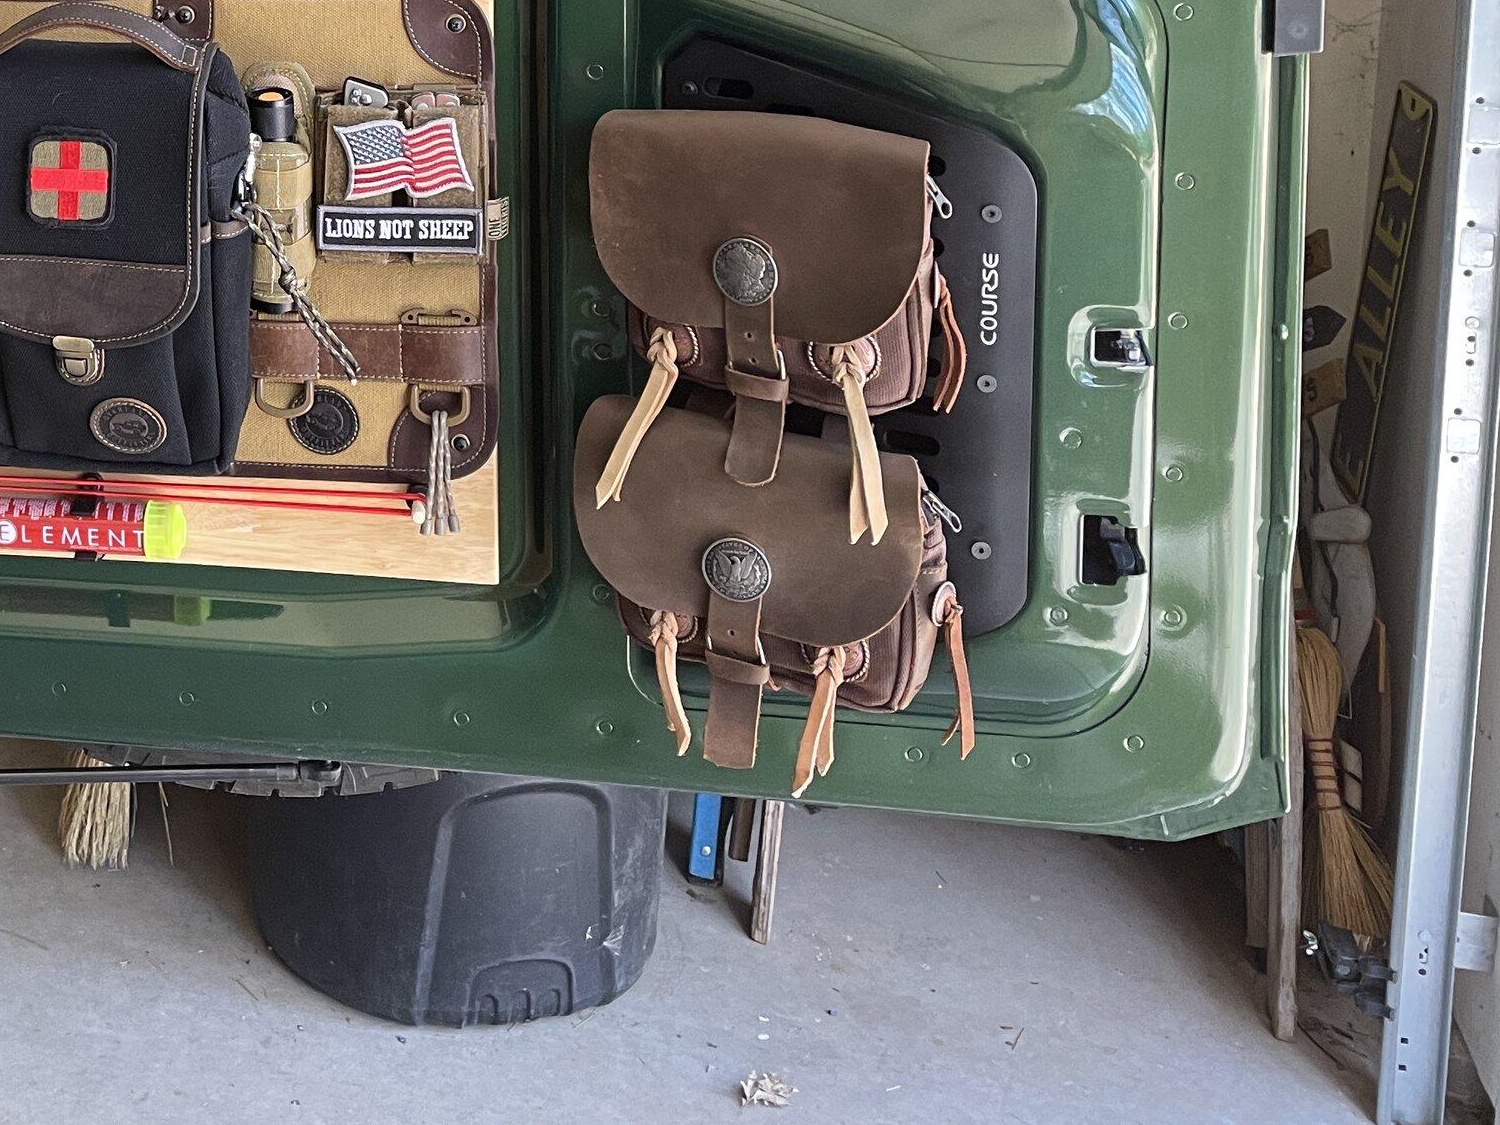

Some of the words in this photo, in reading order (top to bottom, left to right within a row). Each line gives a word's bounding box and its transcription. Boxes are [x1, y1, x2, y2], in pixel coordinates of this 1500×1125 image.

[325, 217, 376, 239] LIONS
[378, 219, 414, 240] NOT
[418, 219, 474, 240] SHEEP
[1355, 147, 1414, 402] ALLEY
[979, 252, 1000, 346] COURSE
